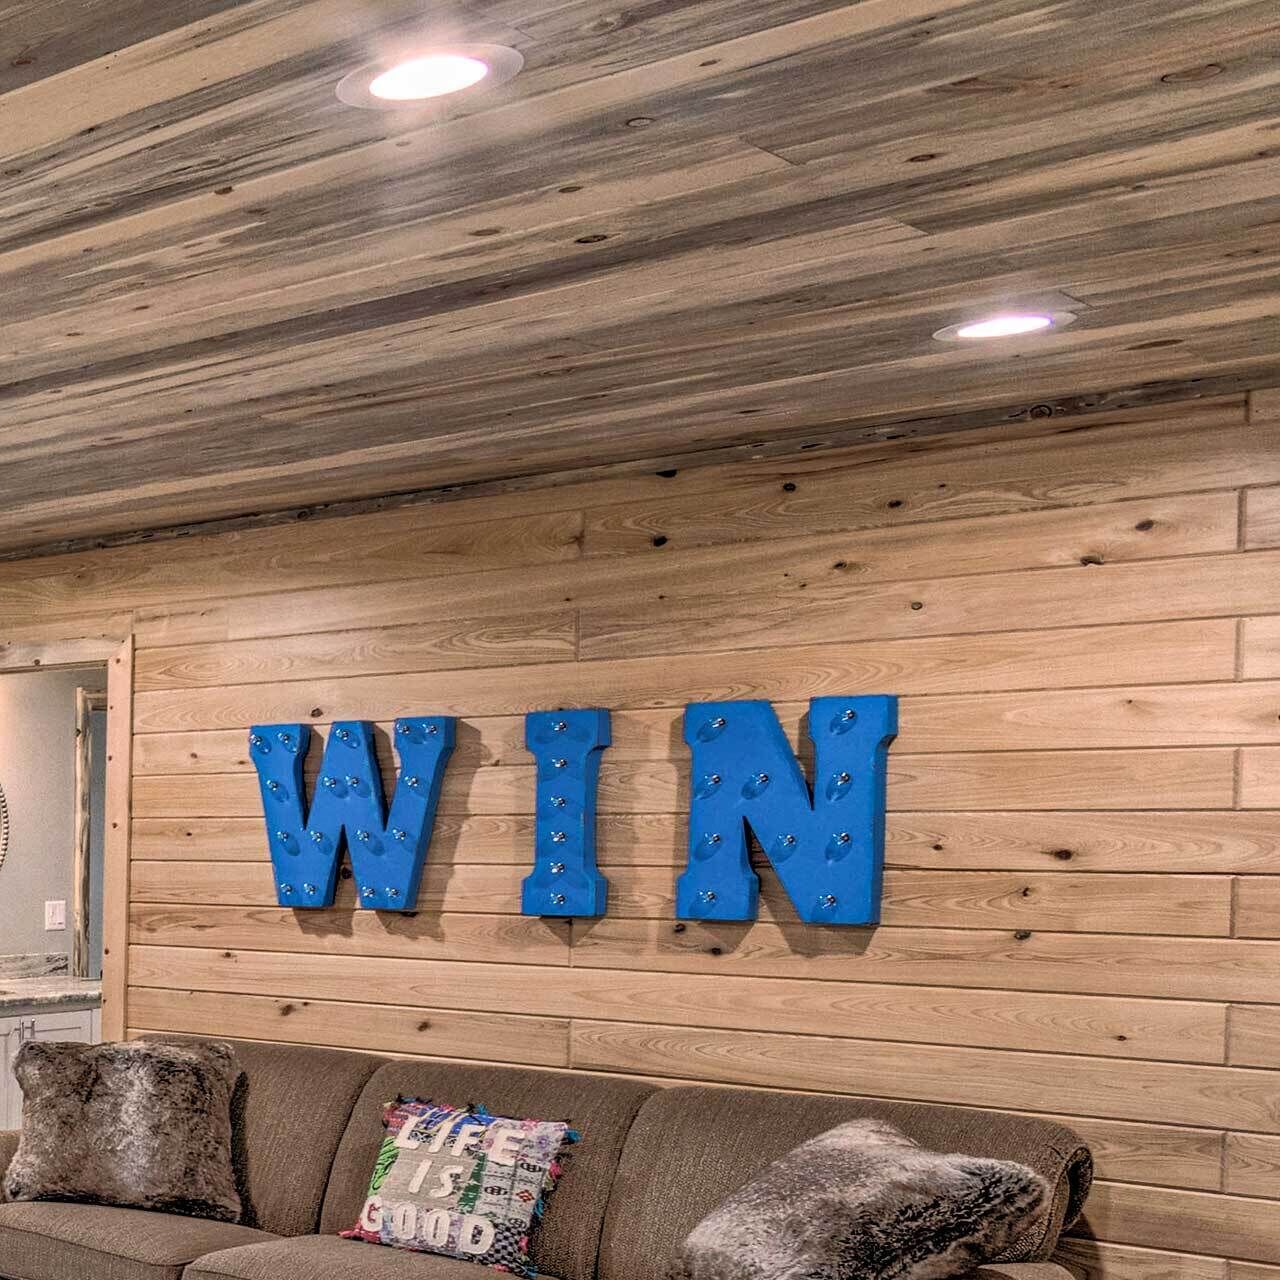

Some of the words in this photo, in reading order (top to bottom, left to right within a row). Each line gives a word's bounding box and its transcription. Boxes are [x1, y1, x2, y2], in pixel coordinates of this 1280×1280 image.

[250, 694, 899, 924] WIN
[396, 1112, 527, 1166] LIFE
[409, 1159, 464, 1198] IS
[362, 1194, 496, 1255] GOOD
